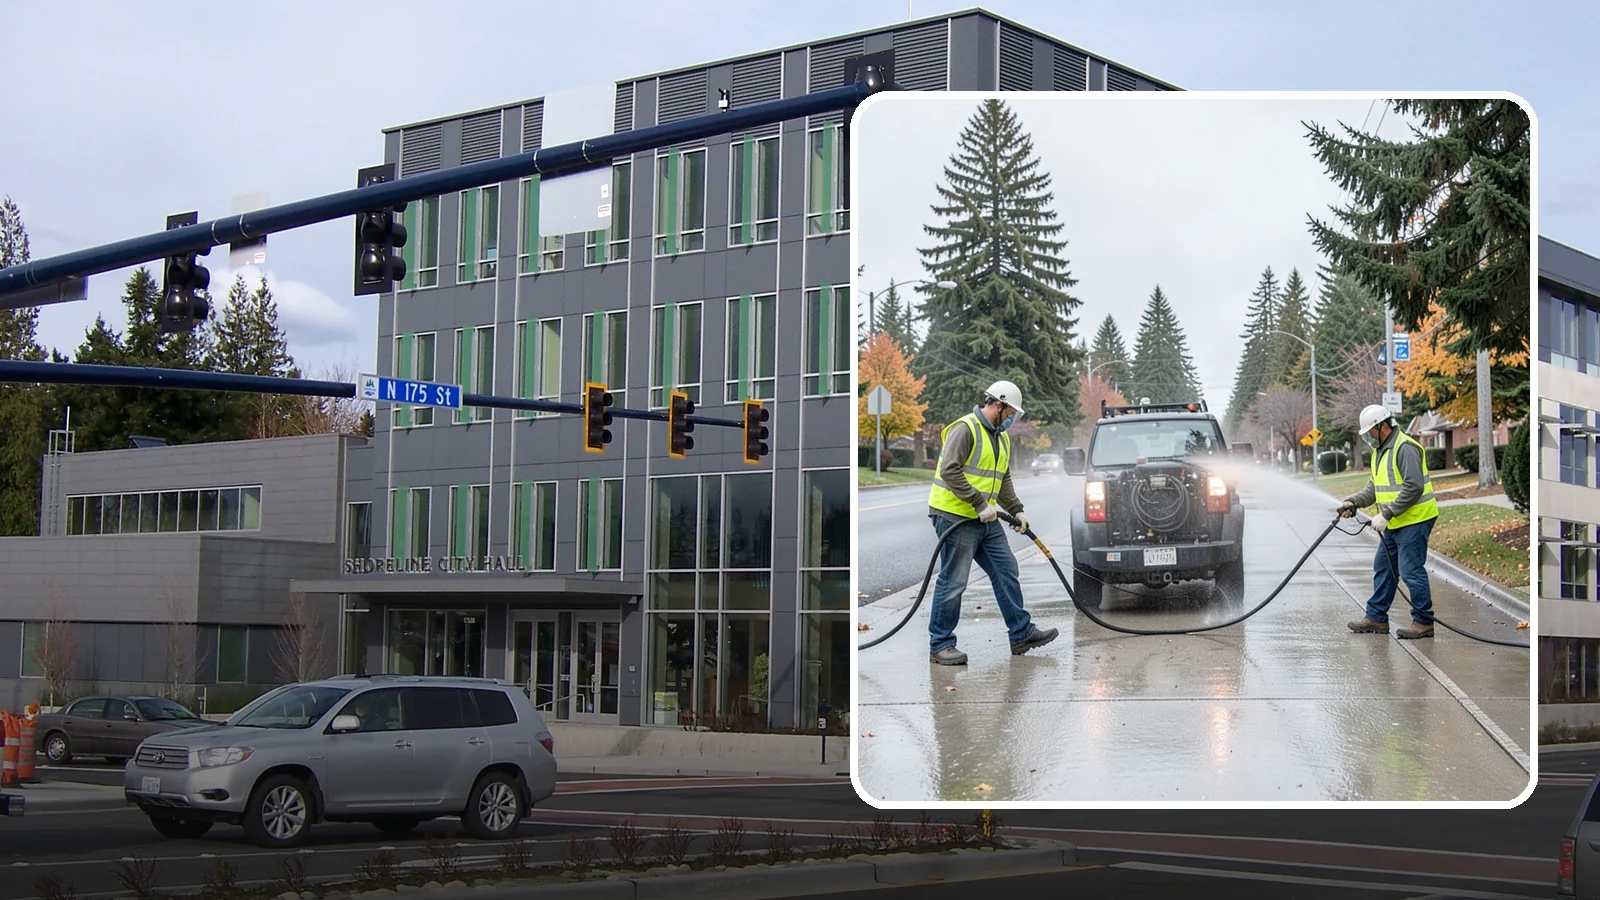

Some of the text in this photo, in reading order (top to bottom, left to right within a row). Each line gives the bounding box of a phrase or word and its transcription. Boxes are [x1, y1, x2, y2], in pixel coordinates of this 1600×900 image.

[387, 380, 451, 406] N 175 St
[345, 555, 526, 574] SHORELINE CITY HALL
